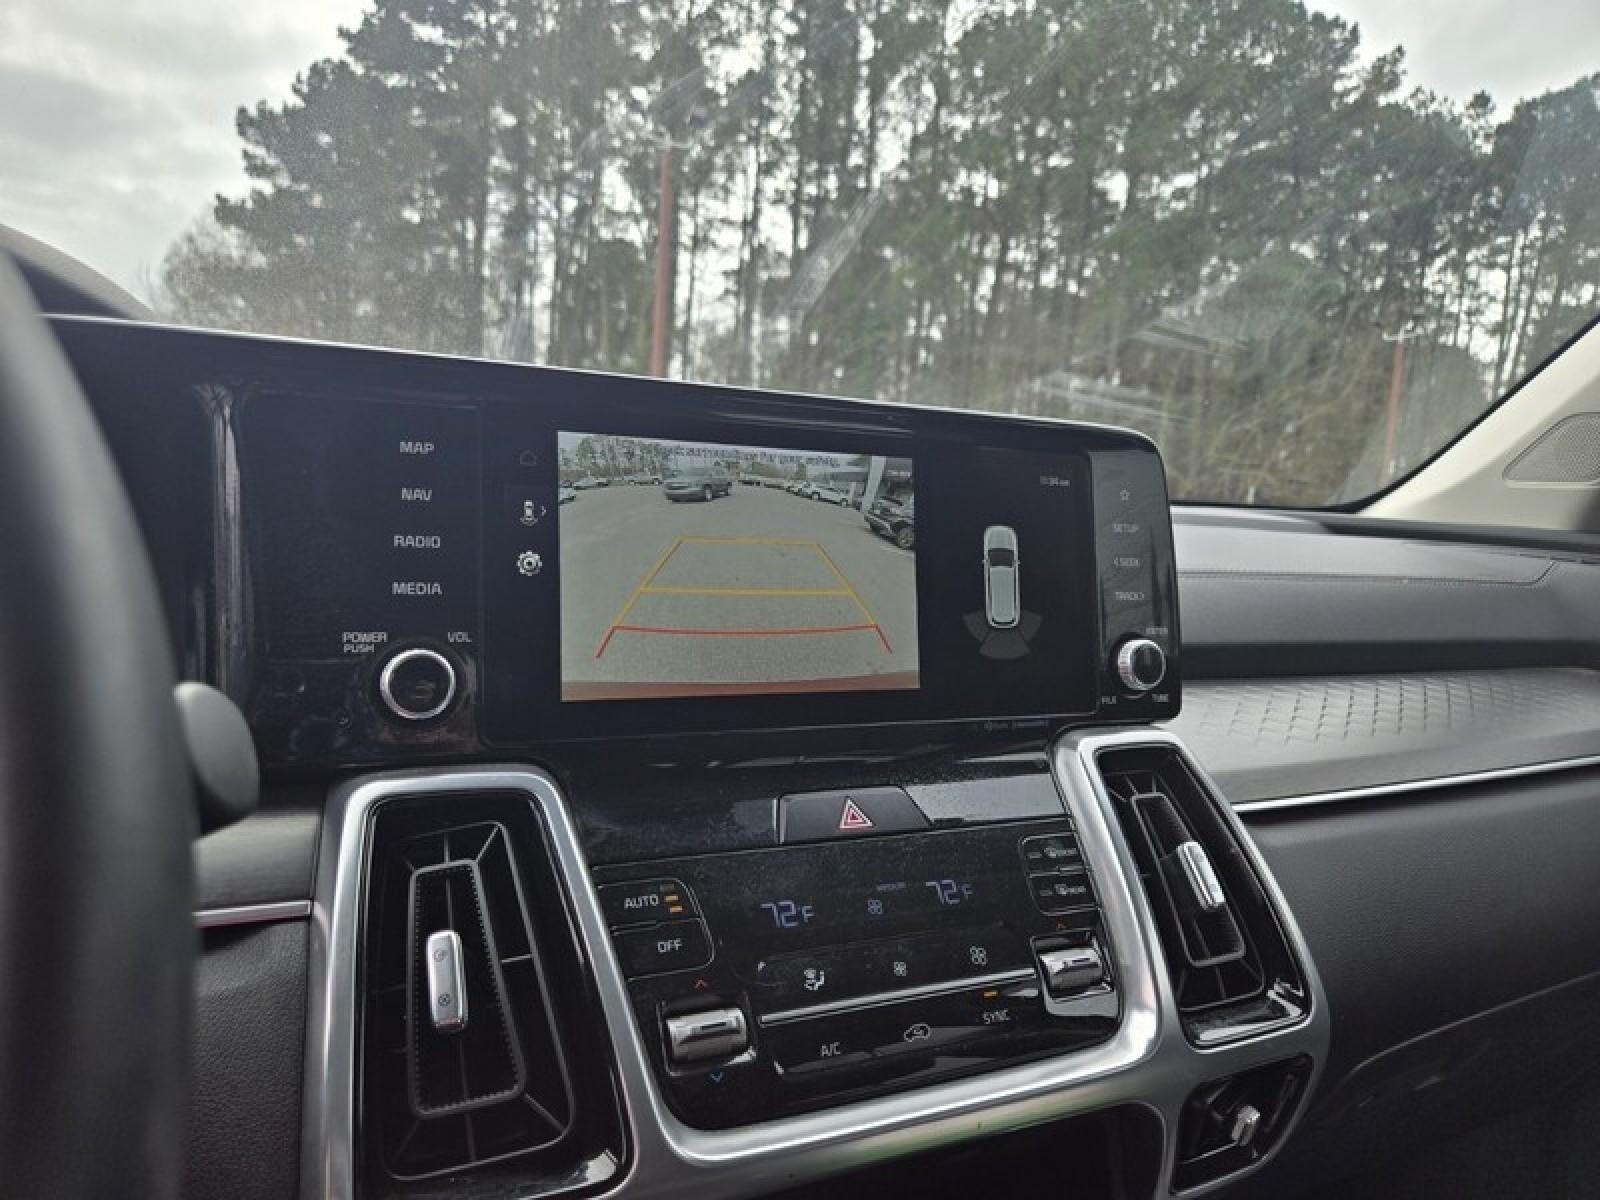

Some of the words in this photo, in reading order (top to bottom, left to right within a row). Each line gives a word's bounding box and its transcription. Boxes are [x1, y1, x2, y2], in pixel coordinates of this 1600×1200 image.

[399, 441, 435, 455] MAP
[401, 487, 432, 501] NAV
[1112, 522, 1140, 534] SETUP
[393, 535, 441, 548] RADIO
[391, 582, 442, 596] MEDIA
[342, 631, 388, 643] POWER
[447, 631, 472, 643] VOL
[343, 643, 375, 653] PUSH
[623, 894, 659, 910] AUTO
[656, 938, 683, 954] OFF
[982, 1008, 1011, 1026] SYNC
[819, 1041, 842, 1058] A/C
